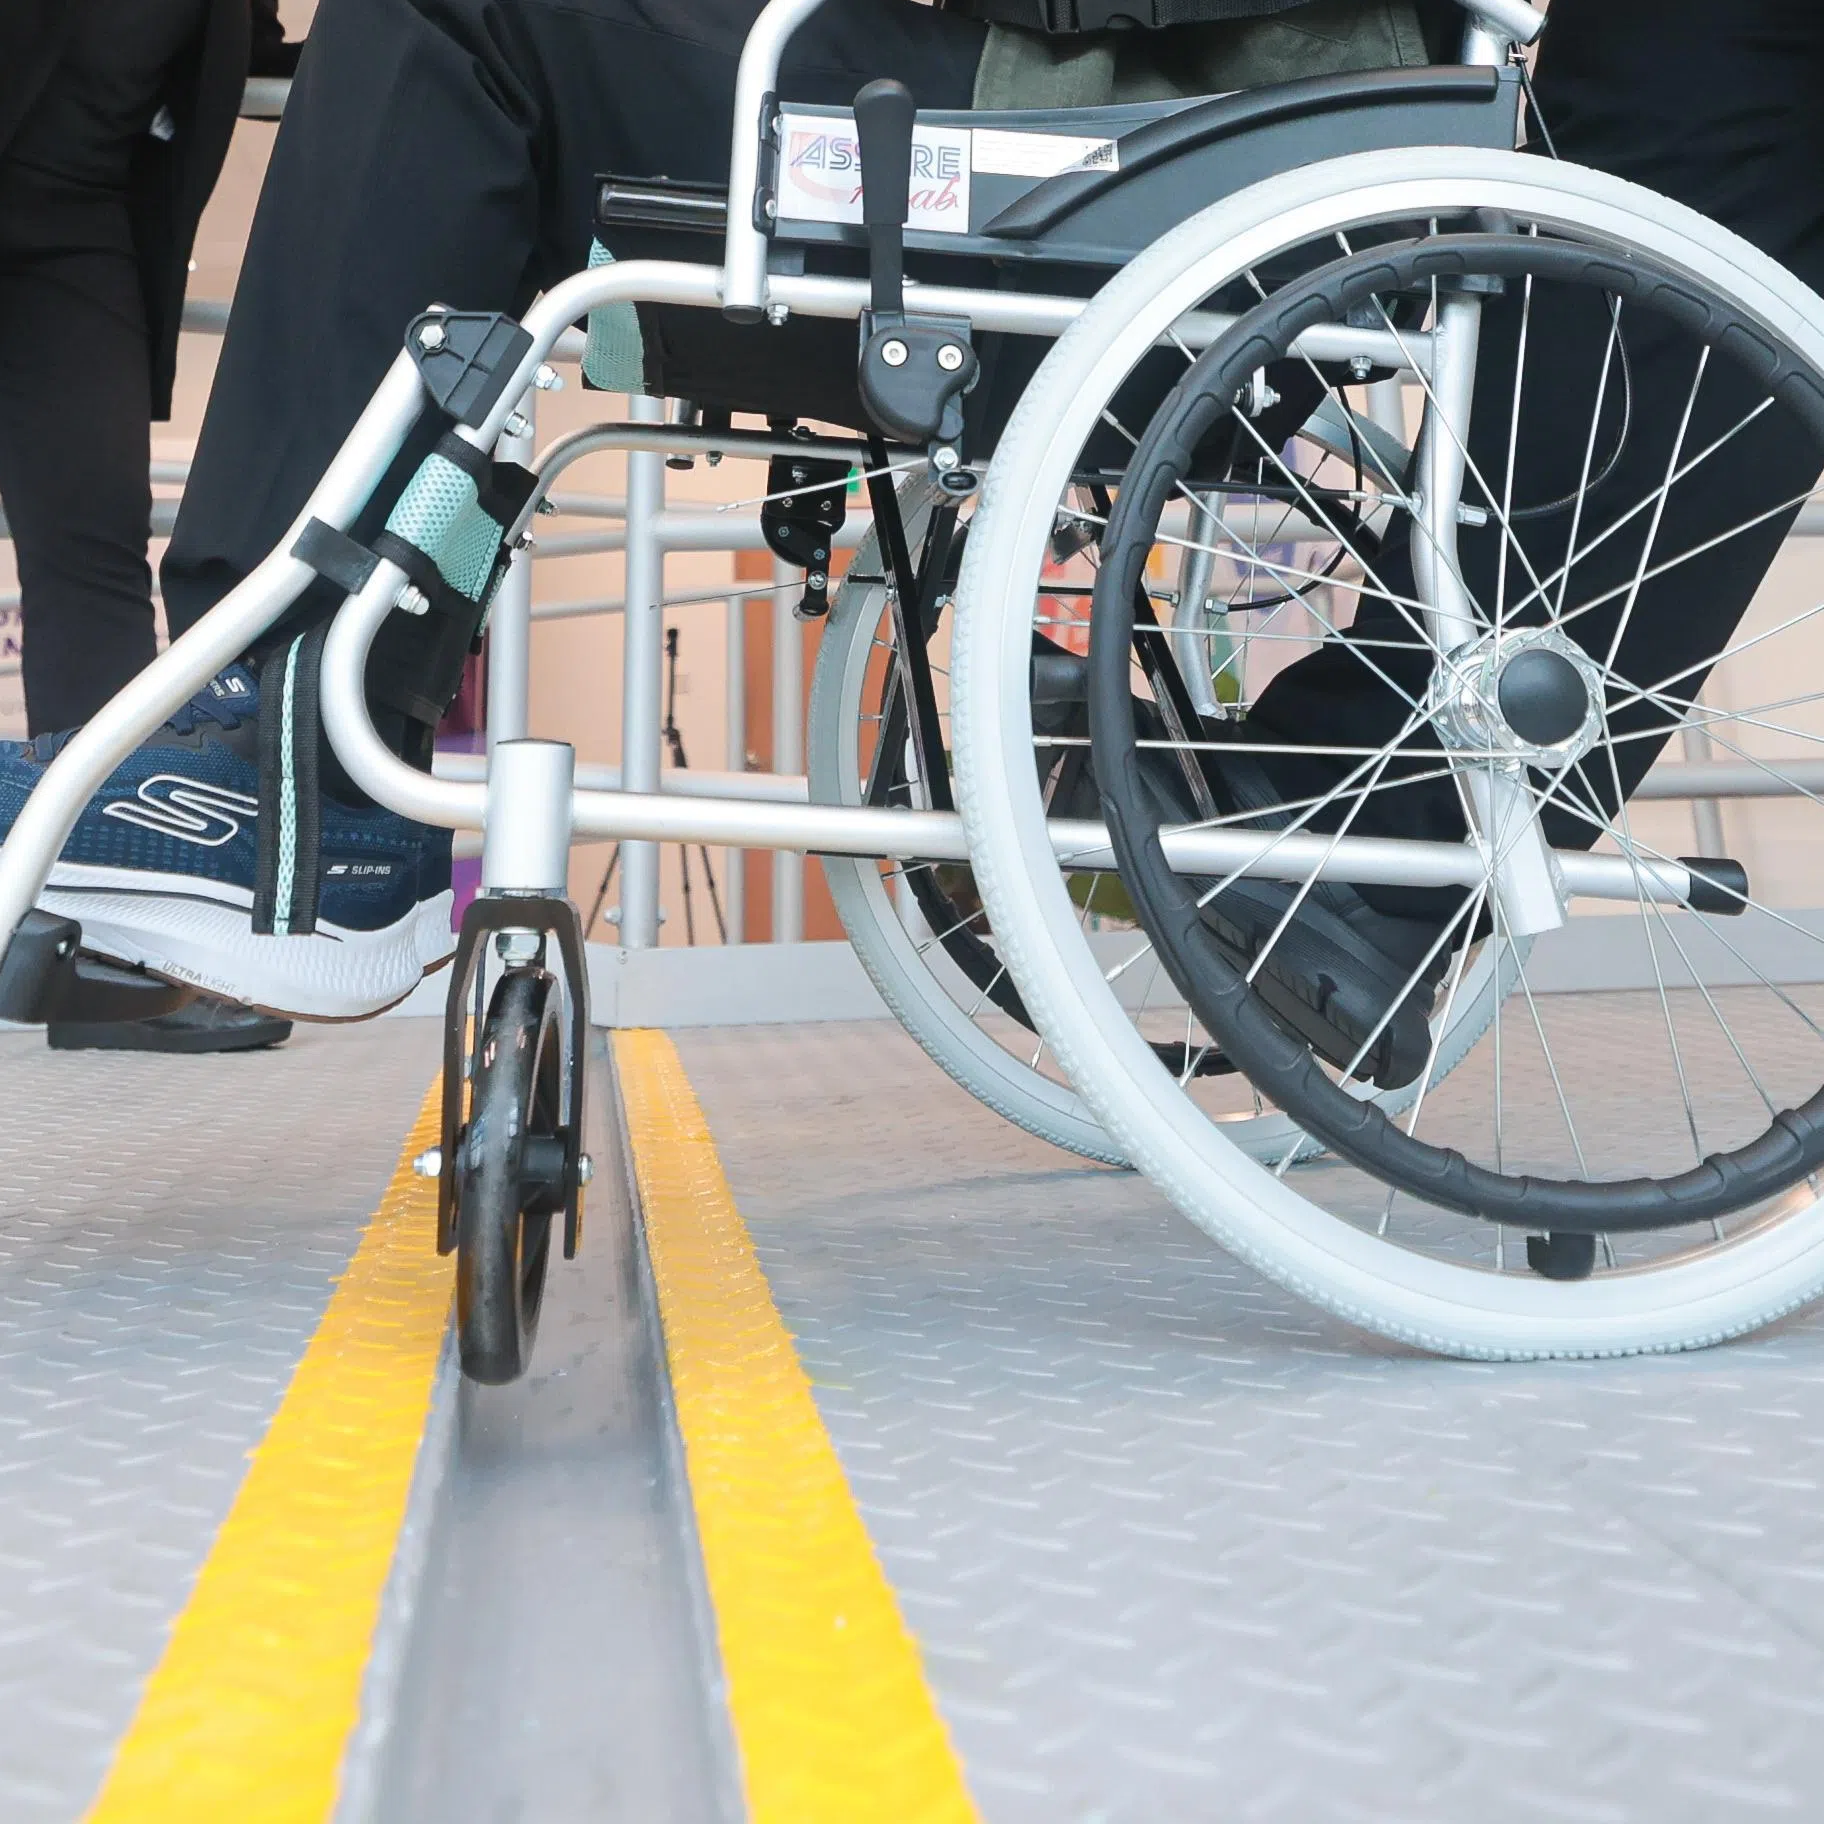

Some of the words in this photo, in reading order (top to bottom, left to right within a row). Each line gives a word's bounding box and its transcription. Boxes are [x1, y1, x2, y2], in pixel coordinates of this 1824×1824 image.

[789, 135, 961, 181] ASRE
[848, 175, 962, 212] rab
[351, 864, 392, 875] SLIP-INS
